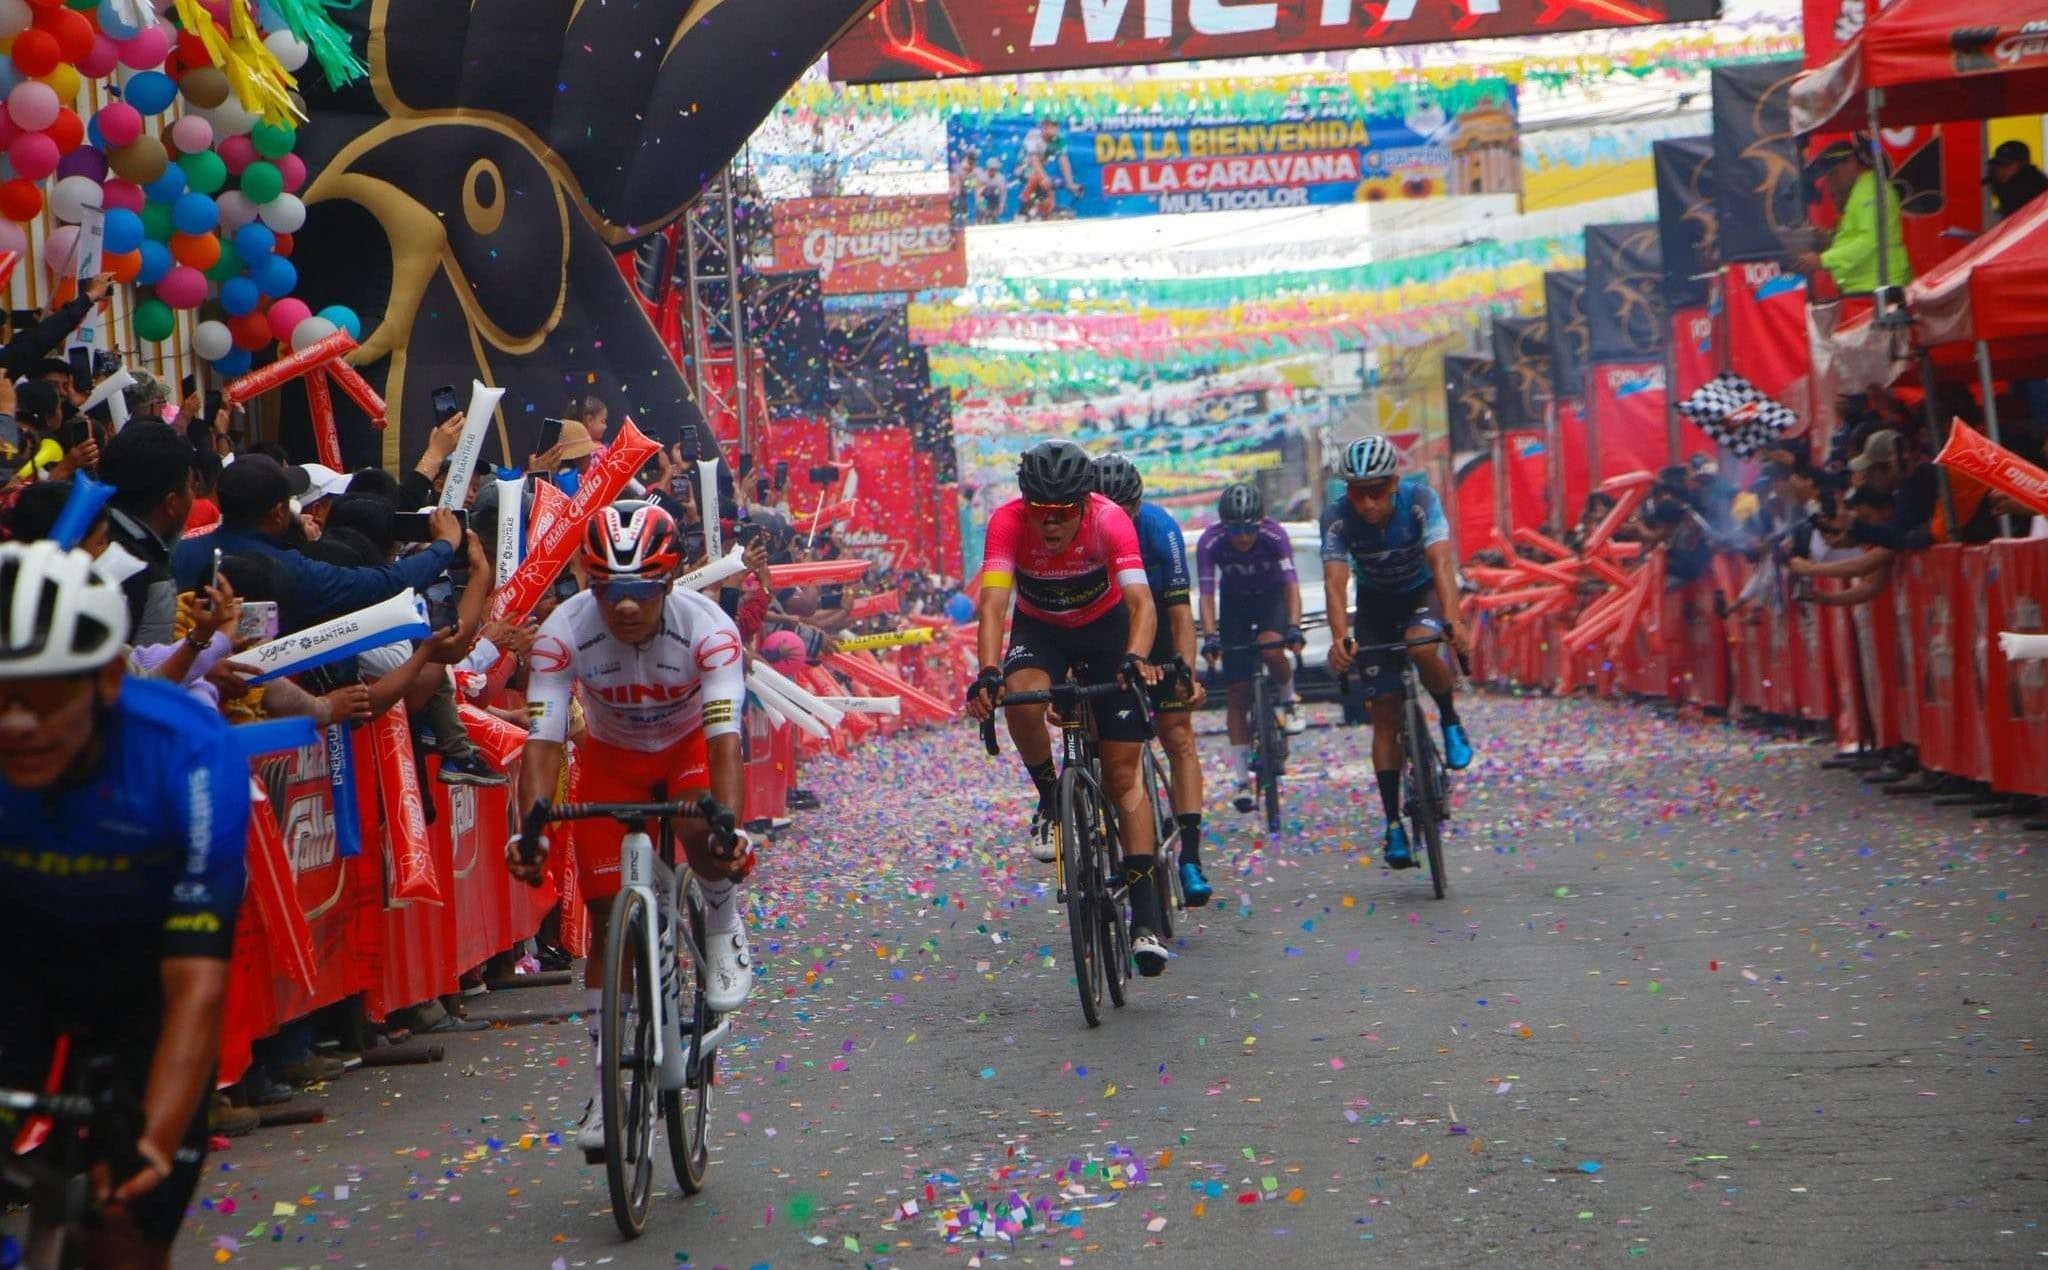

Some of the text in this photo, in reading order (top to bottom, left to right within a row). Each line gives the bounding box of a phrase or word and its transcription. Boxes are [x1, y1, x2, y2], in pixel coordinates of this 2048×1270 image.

[1095, 119, 1370, 162] DA LA BIENVENIDA
[1111, 167, 1134, 193] A
[1140, 164, 1180, 190] LA
[1187, 153, 1357, 188] CARAVANA
[1160, 187, 1308, 213] MULTICOLOR
[609, 511, 621, 543] HINO
[628, 511, 644, 541] HINO
[313, 622, 359, 645] BANTRAB
[1067, 733, 1077, 760] BMC
[630, 850, 640, 881] BMC
